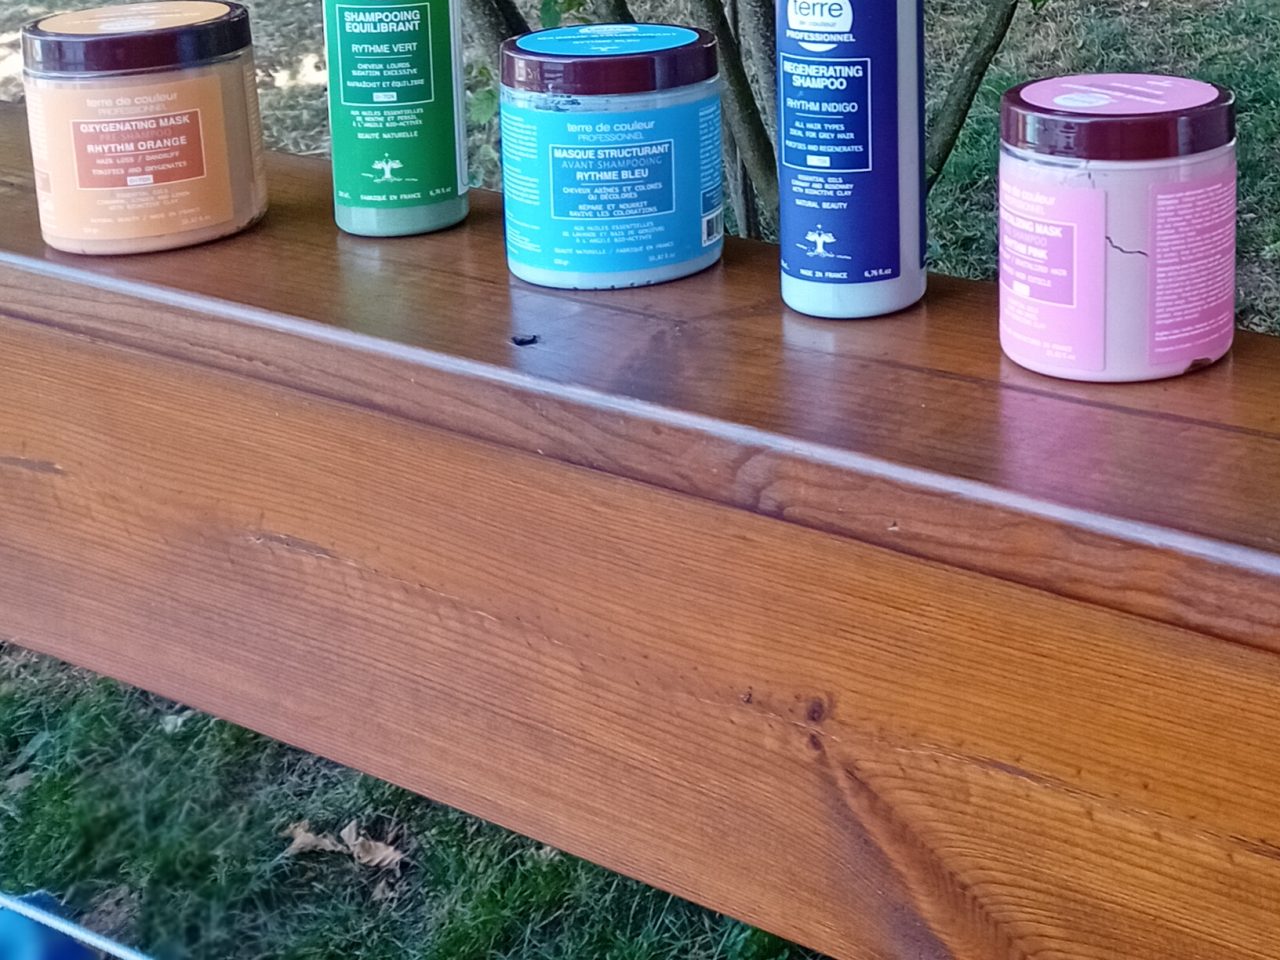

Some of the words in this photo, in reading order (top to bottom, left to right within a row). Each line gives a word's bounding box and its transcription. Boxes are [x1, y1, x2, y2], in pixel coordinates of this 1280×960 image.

[344, 10, 421, 22] SHAMPOOING
[345, 20, 421, 33] EQUILIBRANT
[786, 29, 856, 42] PROFESSIONNEL
[352, 44, 390, 53] RYTHME
[392, 42, 418, 52] VERT
[783, 60, 863, 77] REGENERATING
[792, 75, 847, 90] SHAMPOO
[786, 97, 820, 111] RHYTHM
[821, 102, 858, 113] INDIGO
[80, 120, 157, 133] OXYGENATING
[159, 115, 190, 127] MASK
[567, 123, 593, 132] terre
[595, 123, 611, 132] de
[613, 120, 655, 131] couleur
[578, 131, 643, 142] PROFESSIONNEL
[87, 143, 134, 153] RHYTHM
[138, 136, 187, 150] ORANGE
[554, 148, 596, 159] MASQUE
[597, 143, 670, 159] STRUCTURANT
[562, 161, 594, 169] AVANT
[597, 157, 662, 169] SHAMPOOING
[576, 171, 619, 181] RYTHME
[621, 168, 649, 180] BLEU
